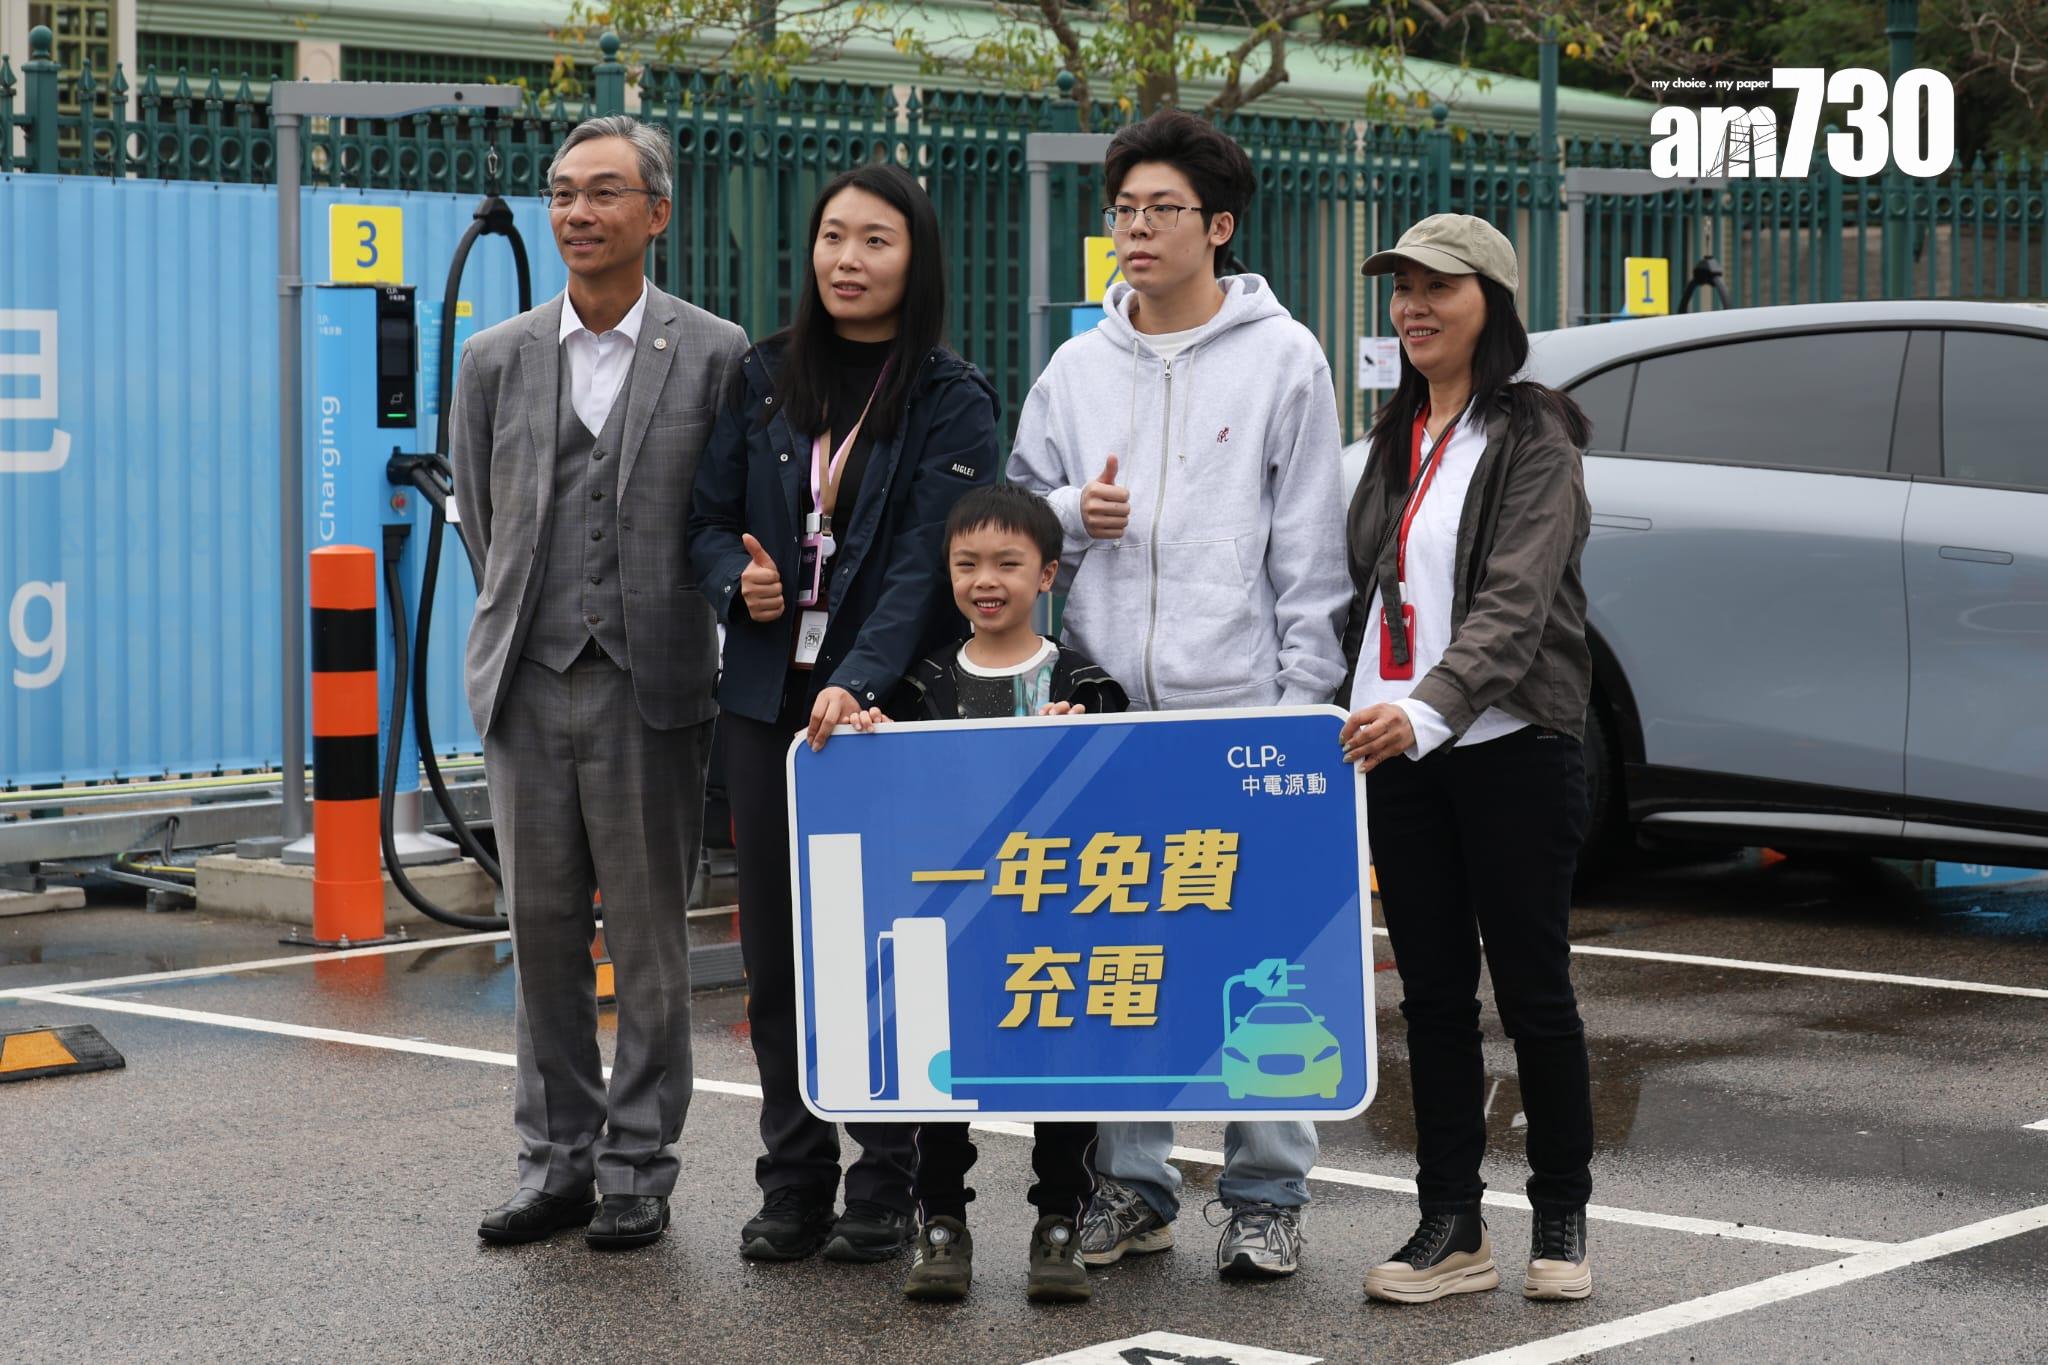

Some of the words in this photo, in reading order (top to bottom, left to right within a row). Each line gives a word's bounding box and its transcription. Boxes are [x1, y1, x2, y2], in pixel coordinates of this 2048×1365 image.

[357, 220, 378, 268] 3
[1641, 269, 1654, 303] 1
[320, 395, 341, 541] Charging
[952, 463, 972, 477] AIGLE
[1227, 745, 1287, 768] CLPe
[1242, 771, 1327, 797] 中電源動
[911, 829, 1239, 914] 一年免費
[997, 945, 1164, 1028] 充電
